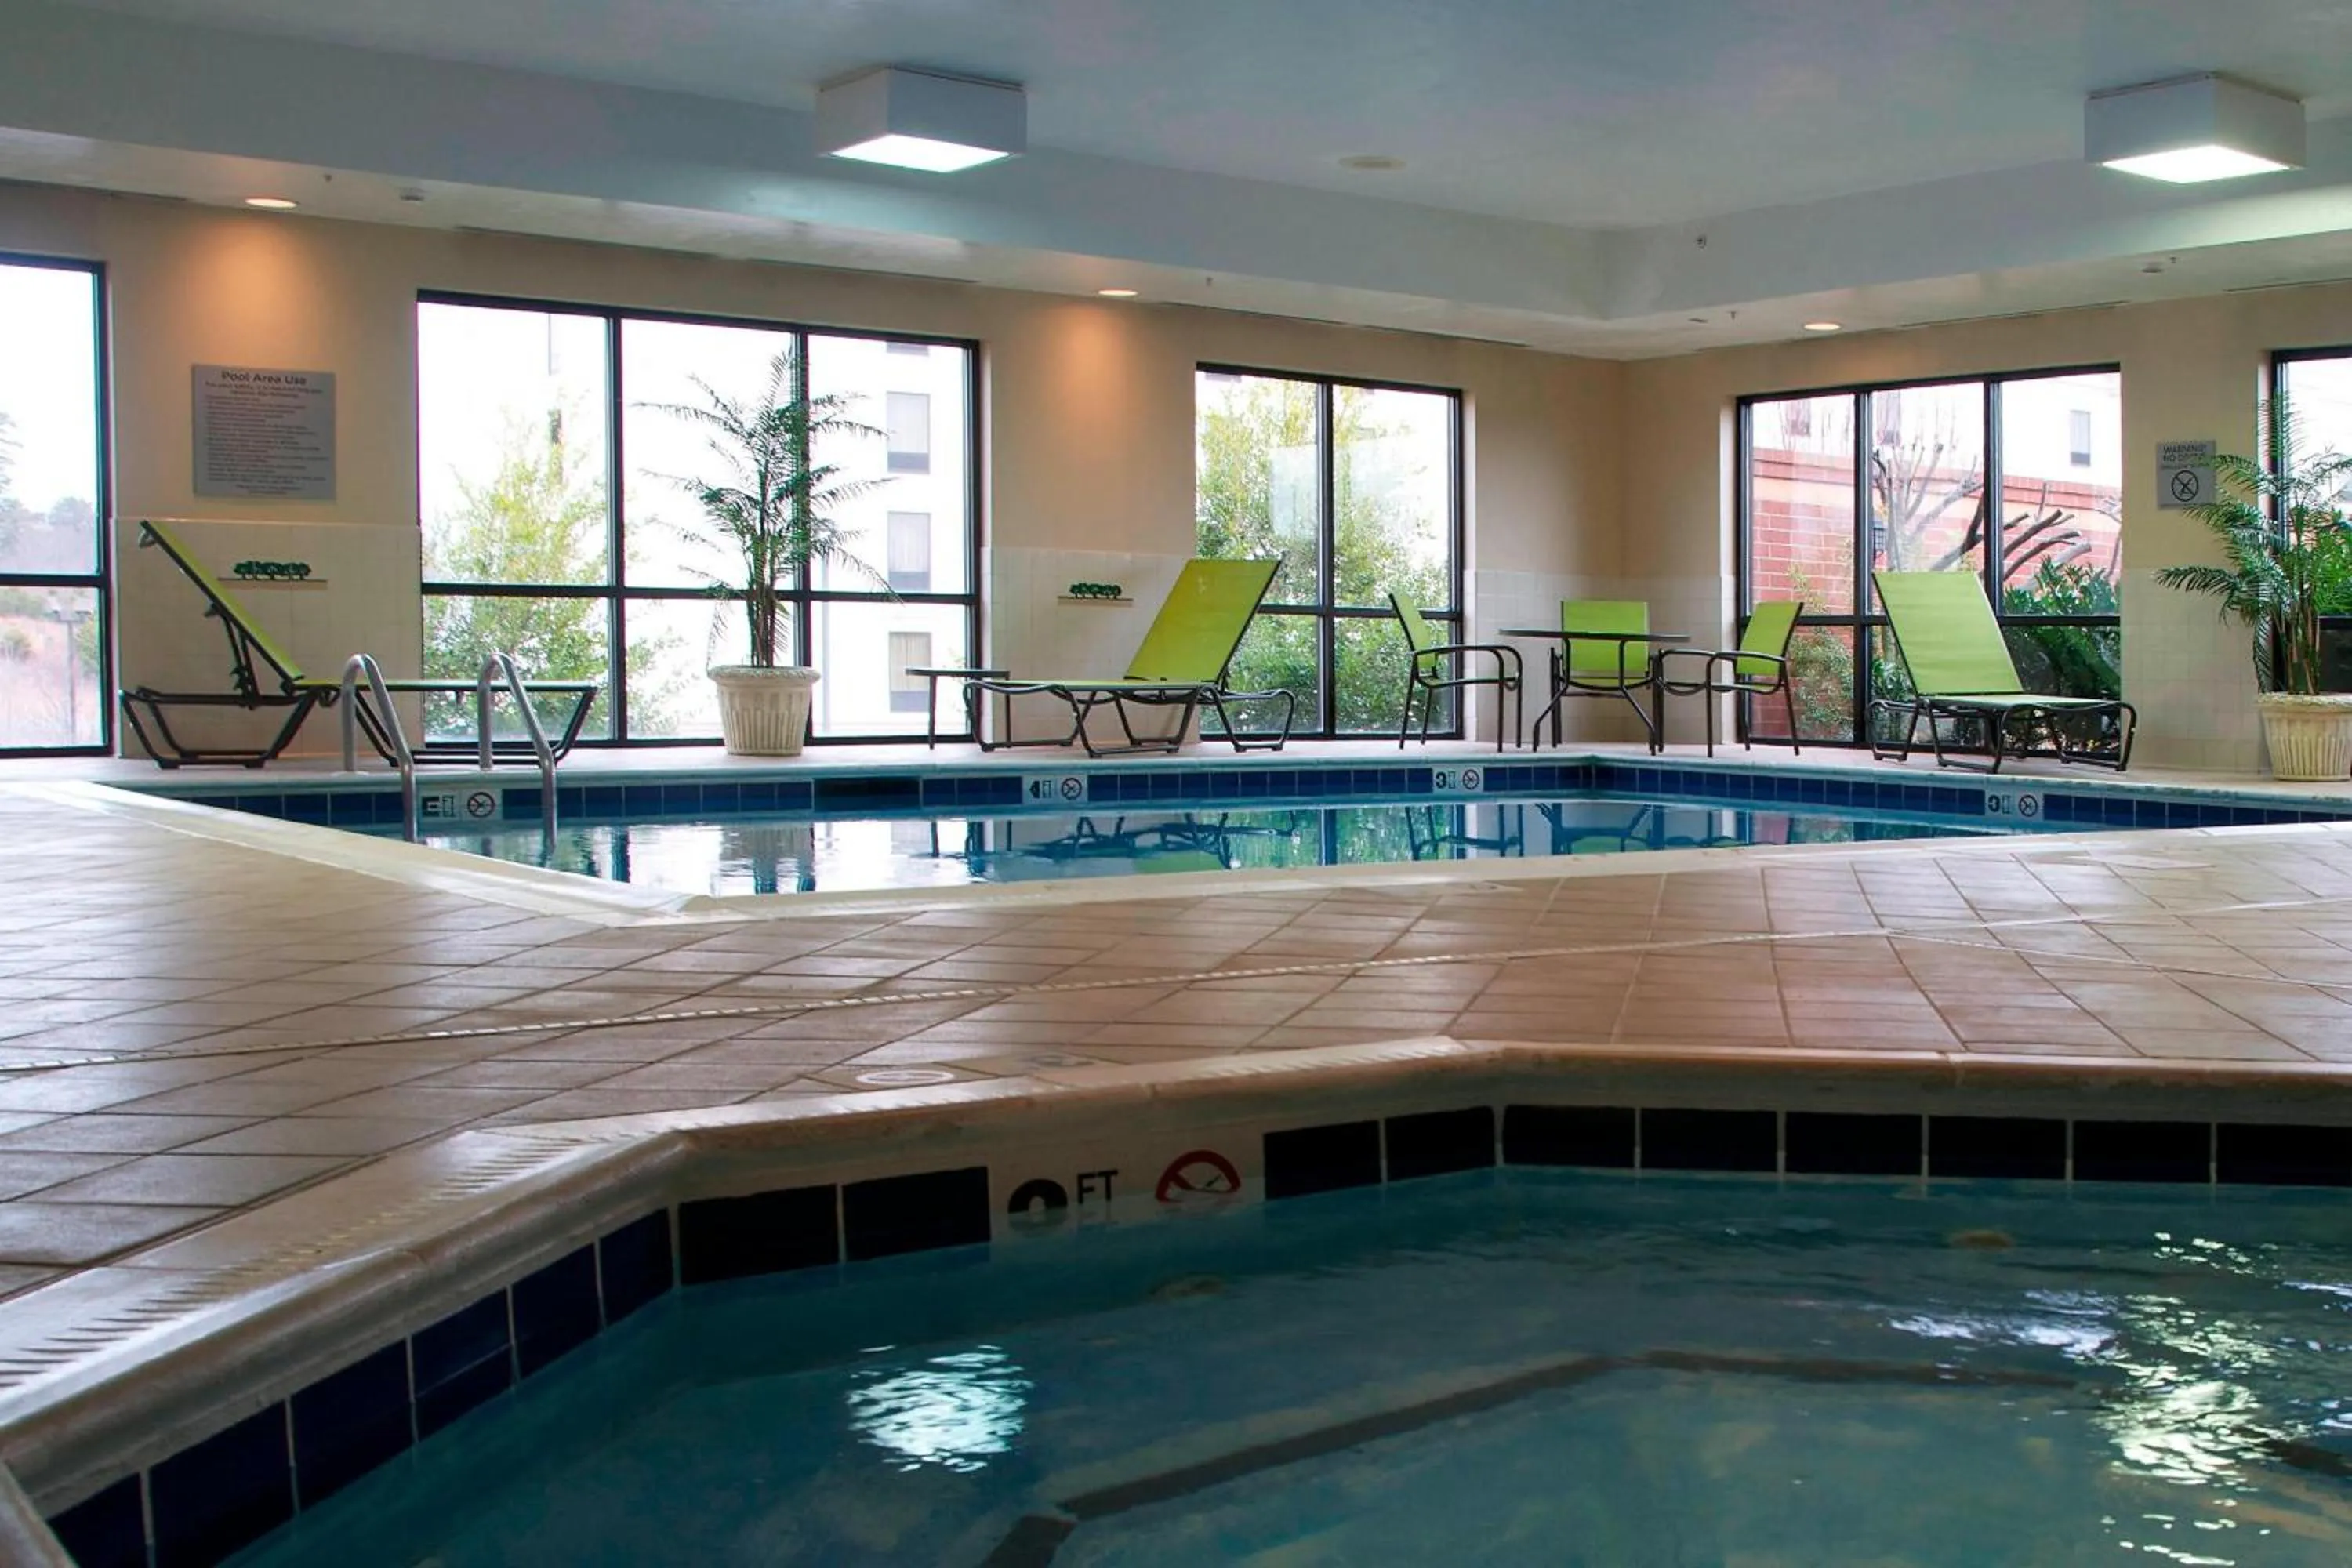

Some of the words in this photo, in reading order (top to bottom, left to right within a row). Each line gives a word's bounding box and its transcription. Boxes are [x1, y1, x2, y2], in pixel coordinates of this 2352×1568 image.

[221, 370, 250, 383] Pool
[253, 373, 281, 383] Area
[285, 375, 307, 385] Use
[1076, 1169, 1119, 1204] FT
